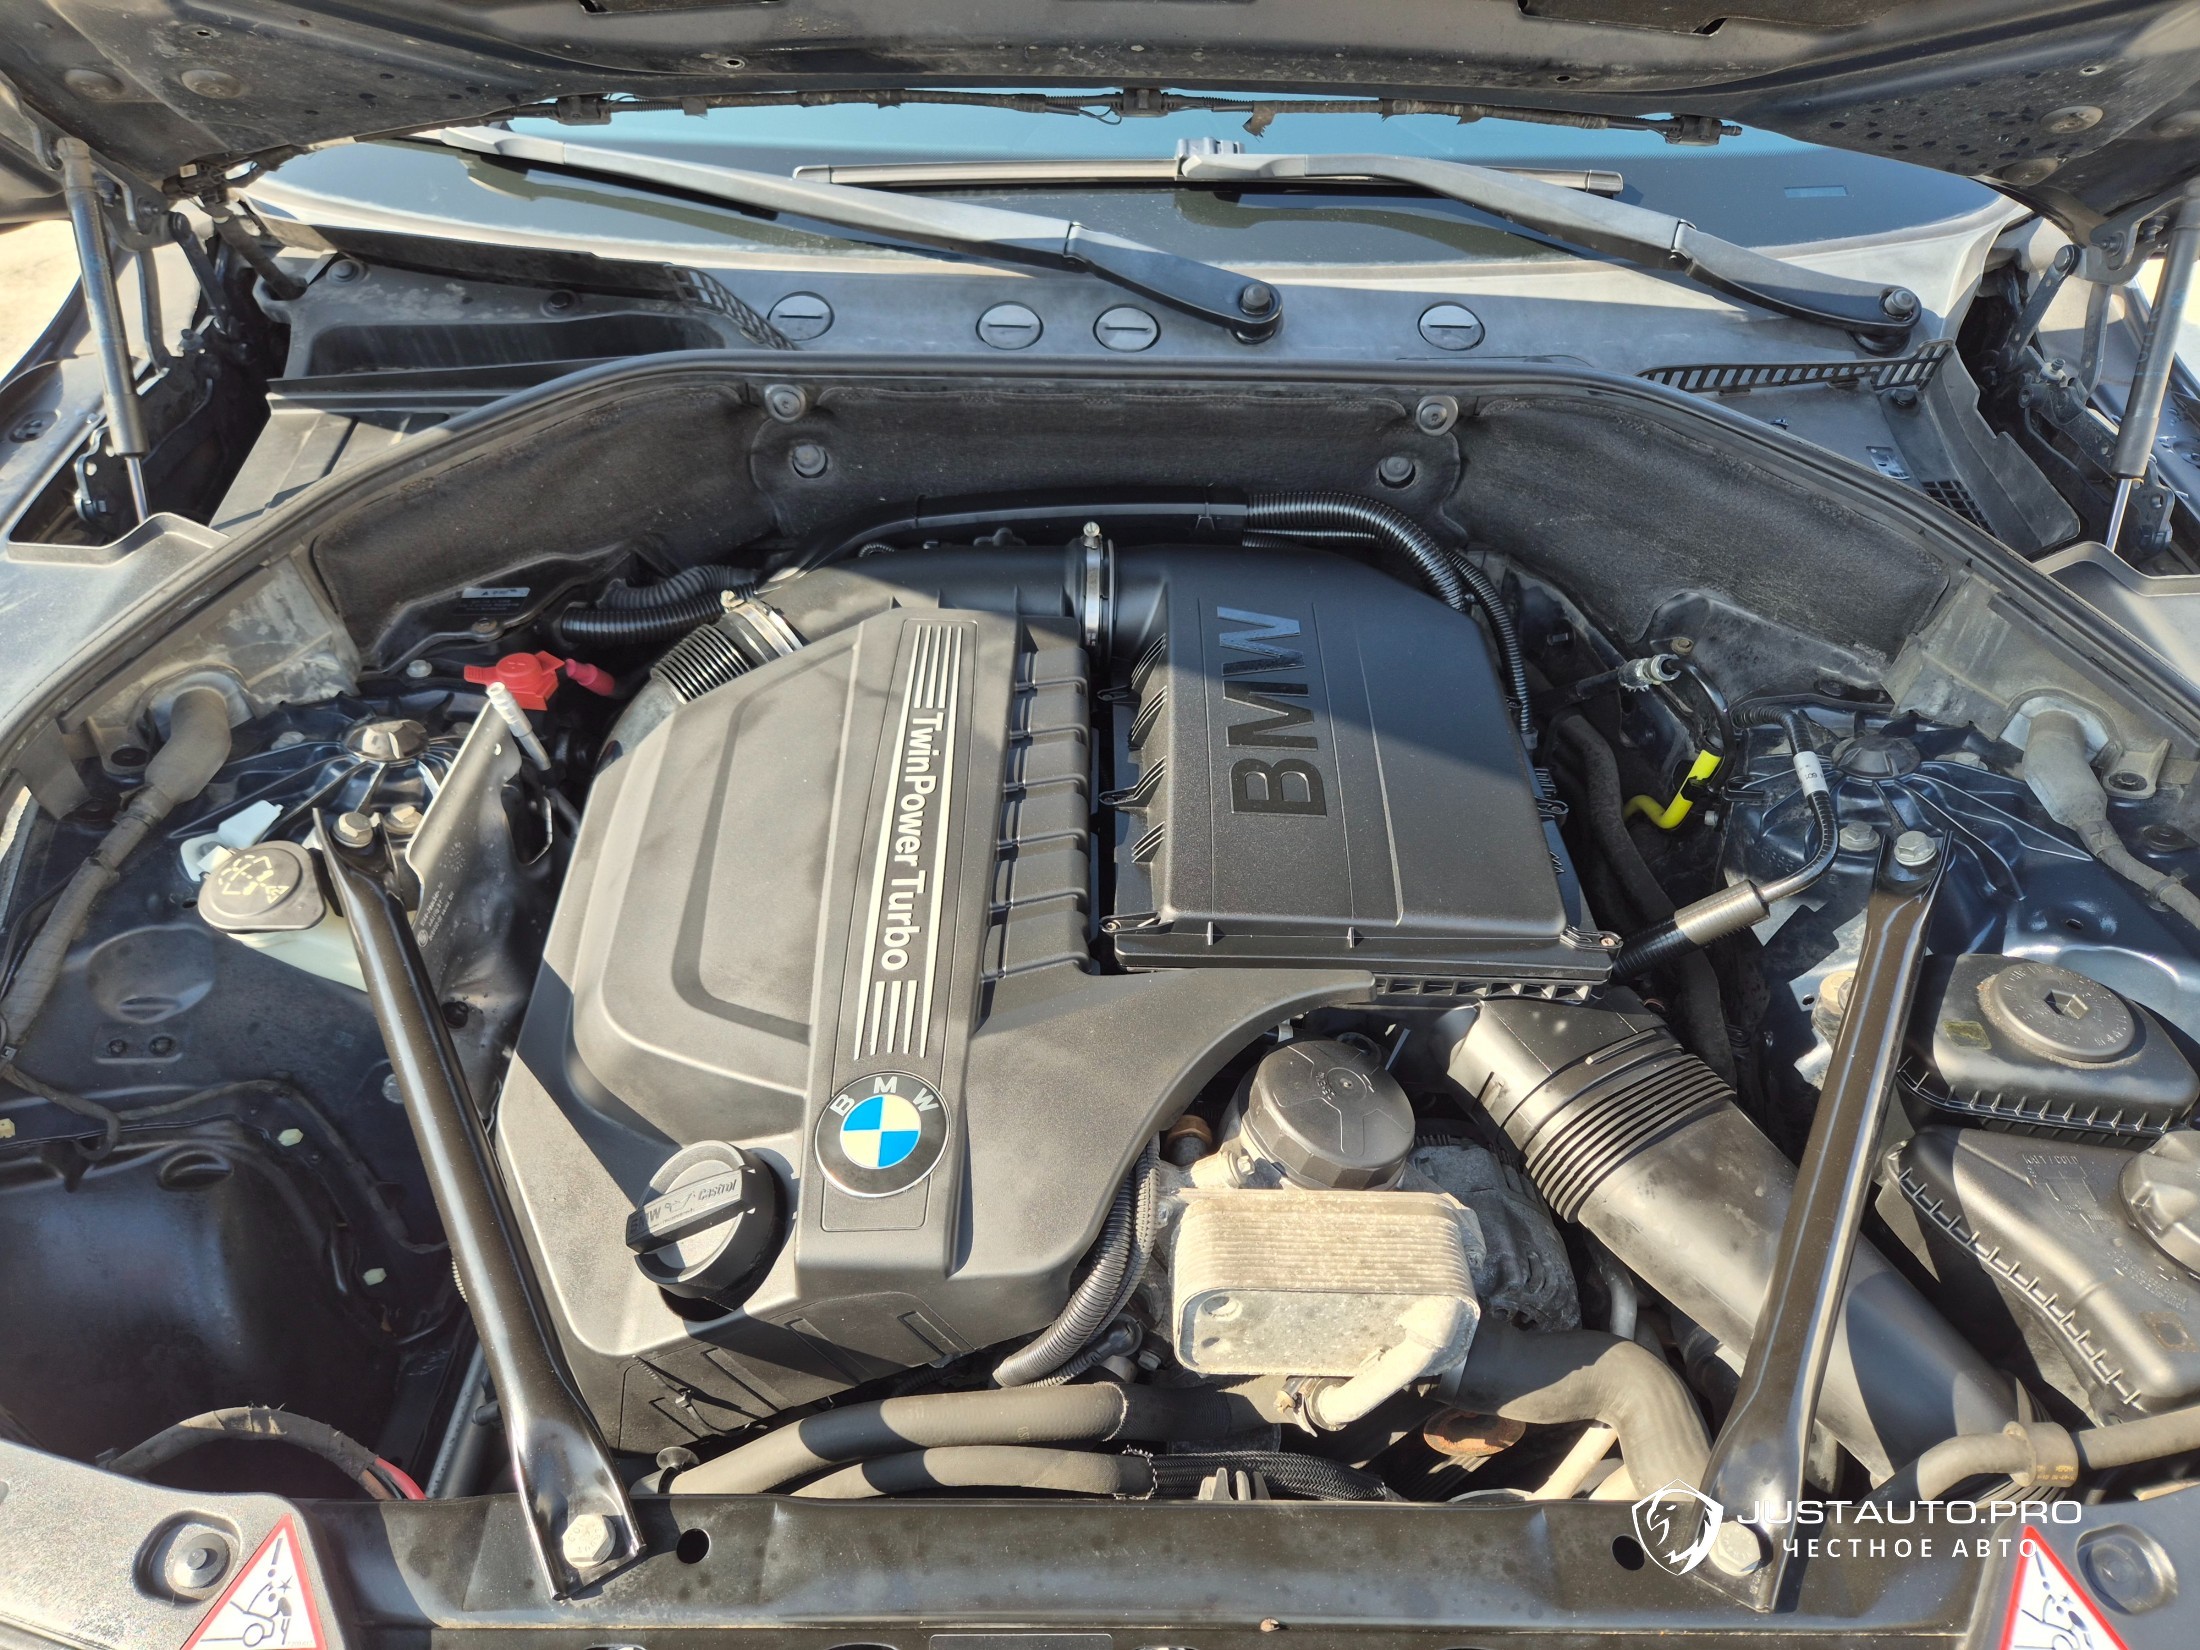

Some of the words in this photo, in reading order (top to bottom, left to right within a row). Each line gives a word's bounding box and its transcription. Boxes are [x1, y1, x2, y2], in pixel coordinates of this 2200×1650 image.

[1217, 606, 1327, 818] BMW
[894, 712, 944, 867] TwinPower
[881, 870, 926, 971] Turbo
[830, 1076, 939, 1117] BMW
